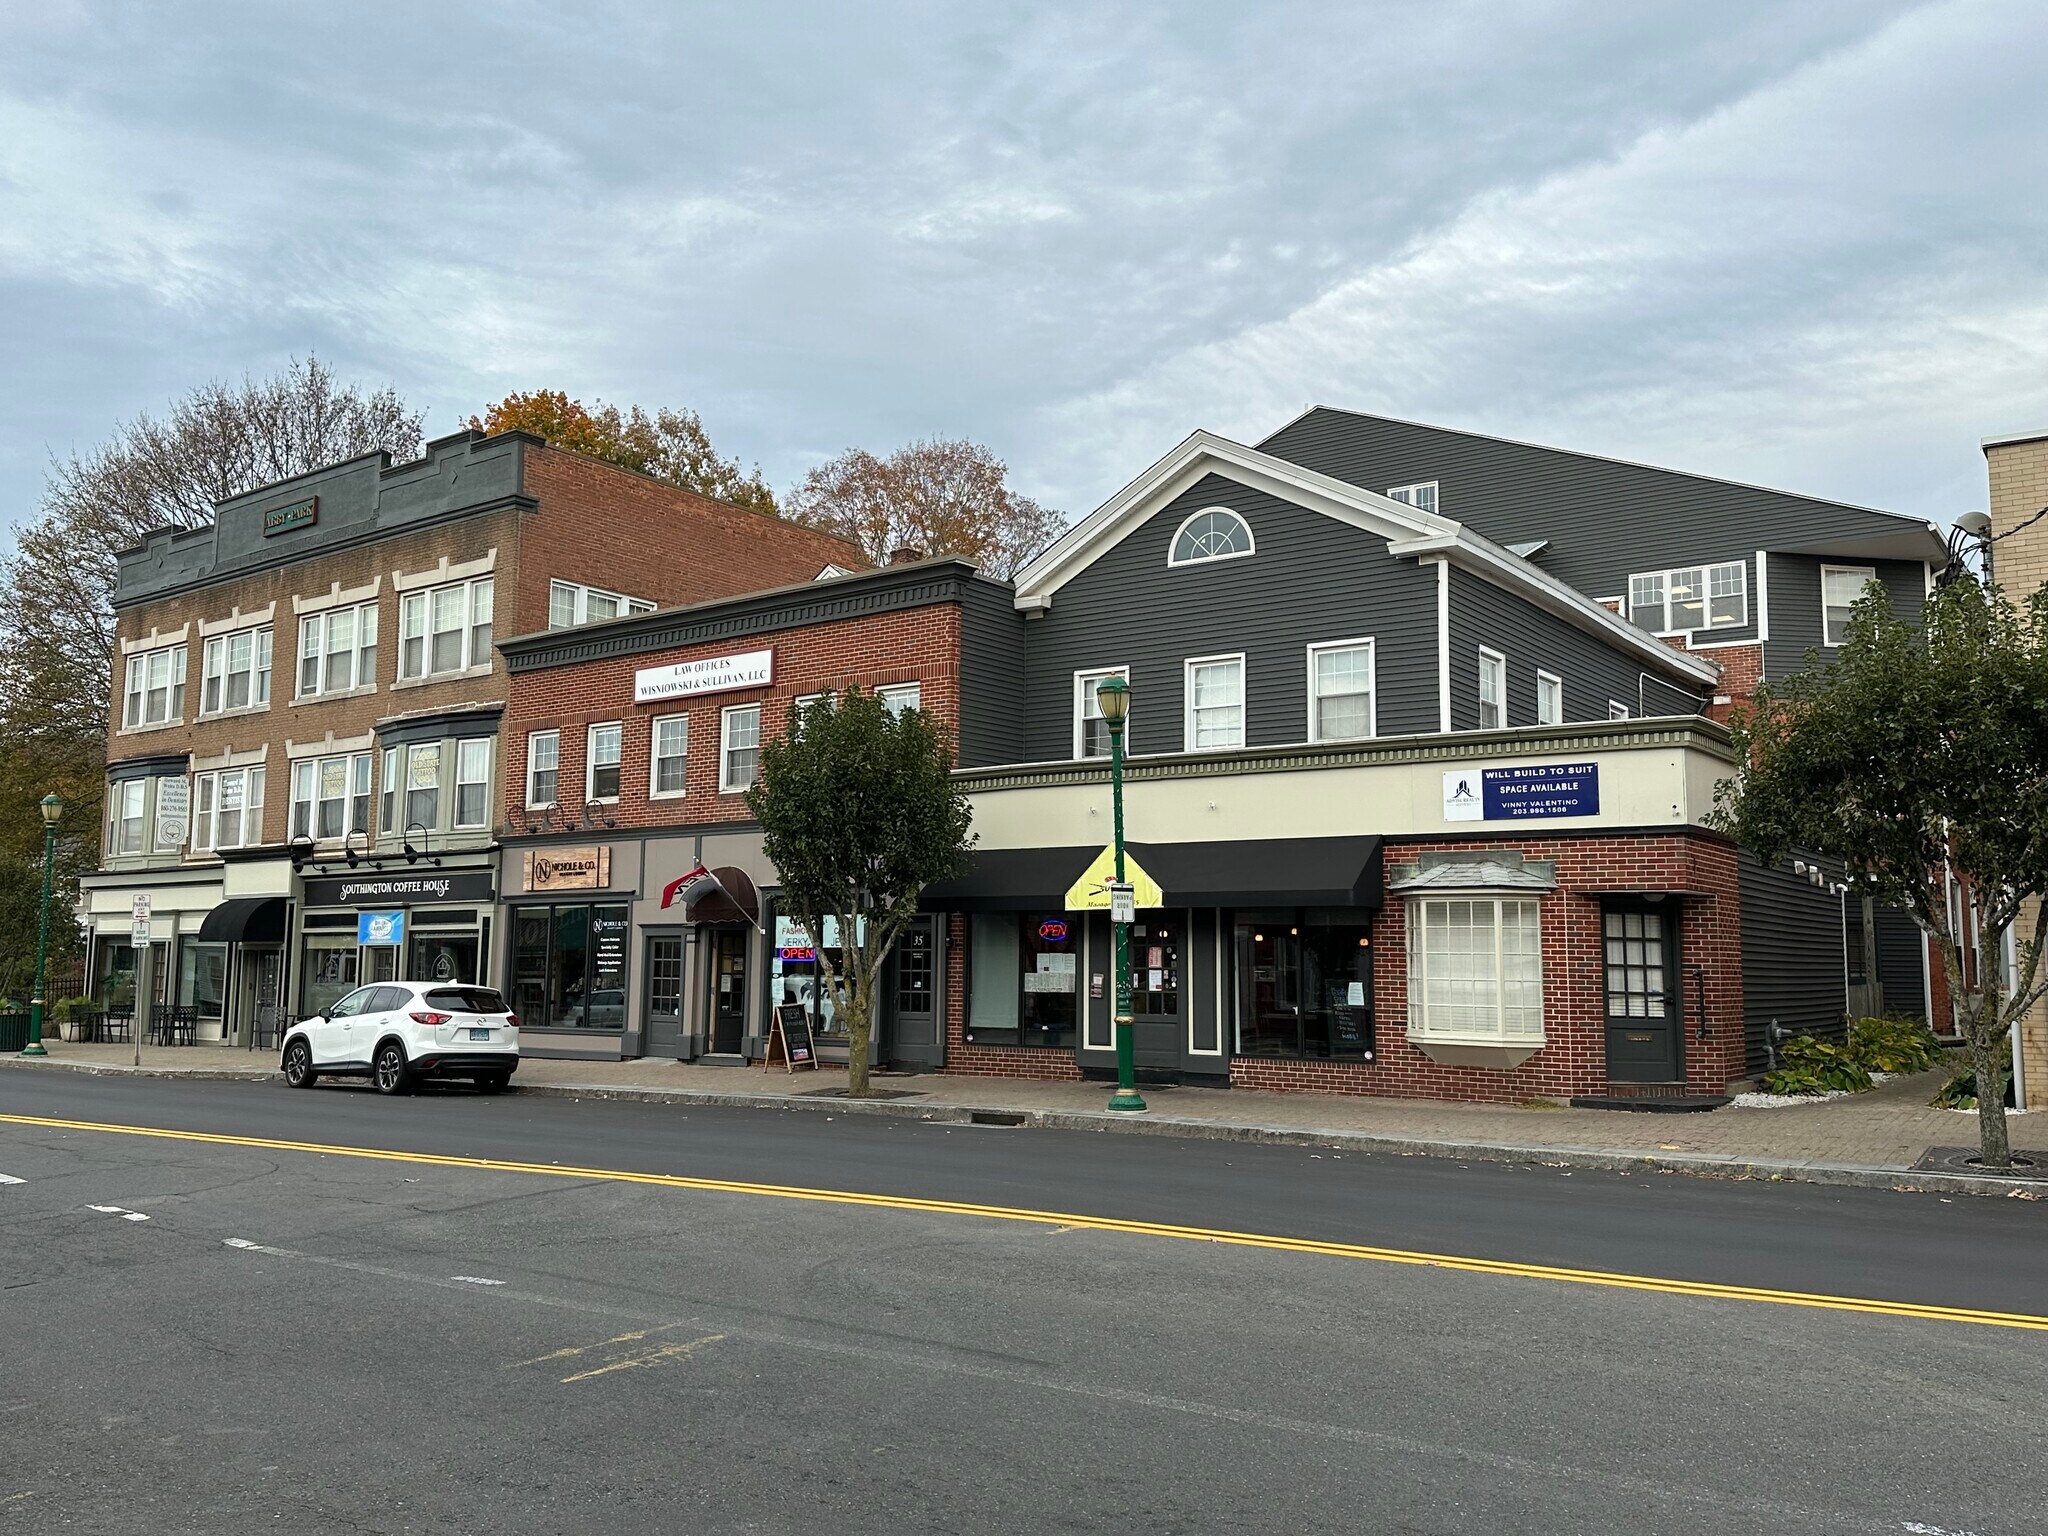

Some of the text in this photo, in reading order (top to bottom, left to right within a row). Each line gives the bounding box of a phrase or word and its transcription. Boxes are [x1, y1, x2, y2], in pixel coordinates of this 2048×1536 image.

[290, 505, 313, 520] PARK
[674, 659, 730, 676] LAW OFFICES
[641, 669, 767, 696] WISNIOWSKI & SULLIVAN, LLC
[1485, 766, 1594, 779] WILL BUILD TO SUIT
[1499, 782, 1579, 794] SPACE AVAILABLE
[1529, 799, 1578, 807] VALENTINO
[551, 862, 578, 872] NICHOLE
[578, 861, 585, 870] &
[340, 880, 450, 901] SOUTHINGTON COFFEE HOUSE
[1039, 925, 1067, 936] OPEN
[913, 935, 924, 946] 35
[781, 948, 814, 959] OPEN
